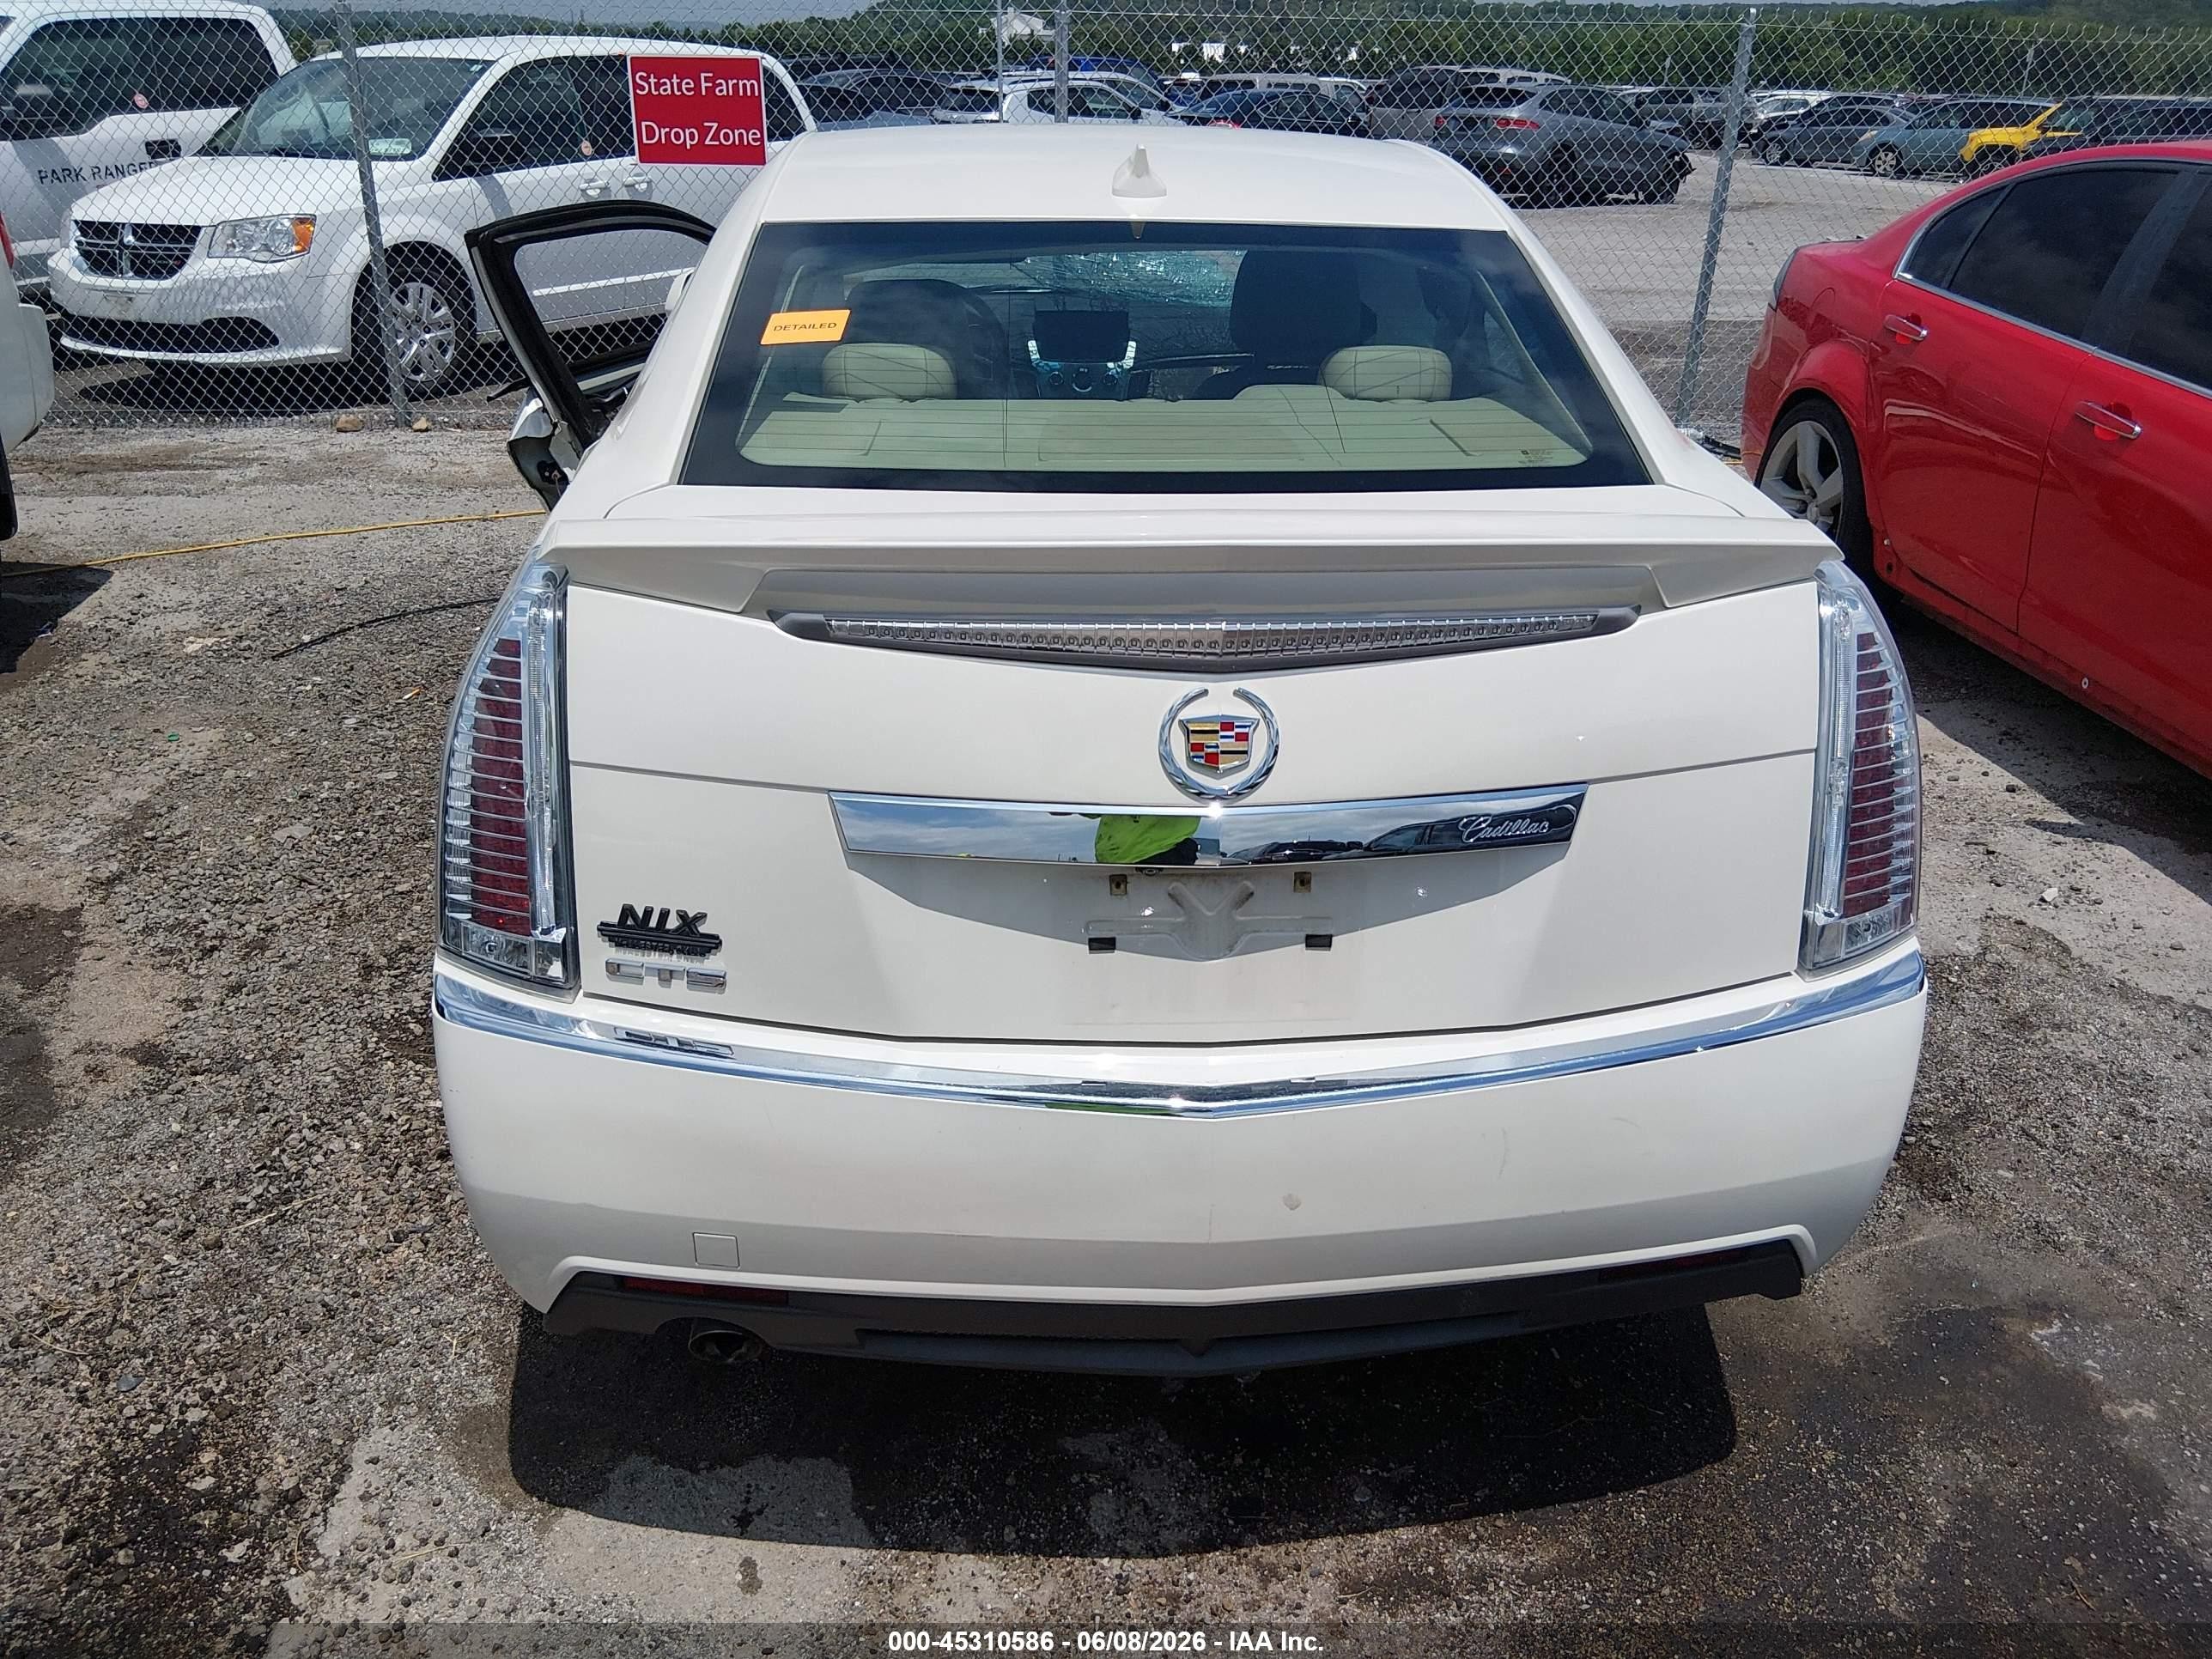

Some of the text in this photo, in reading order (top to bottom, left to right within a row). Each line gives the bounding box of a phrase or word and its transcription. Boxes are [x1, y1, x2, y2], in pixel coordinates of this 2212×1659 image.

[635, 71, 759, 97] State Farm
[641, 121, 762, 149] Drop Zone
[37, 167, 87, 185] PARK
[773, 322, 837, 331] DETAILED
[1458, 816, 1550, 843] Cadillac
[617, 903, 708, 937] NIX
[605, 957, 726, 991] CTS
